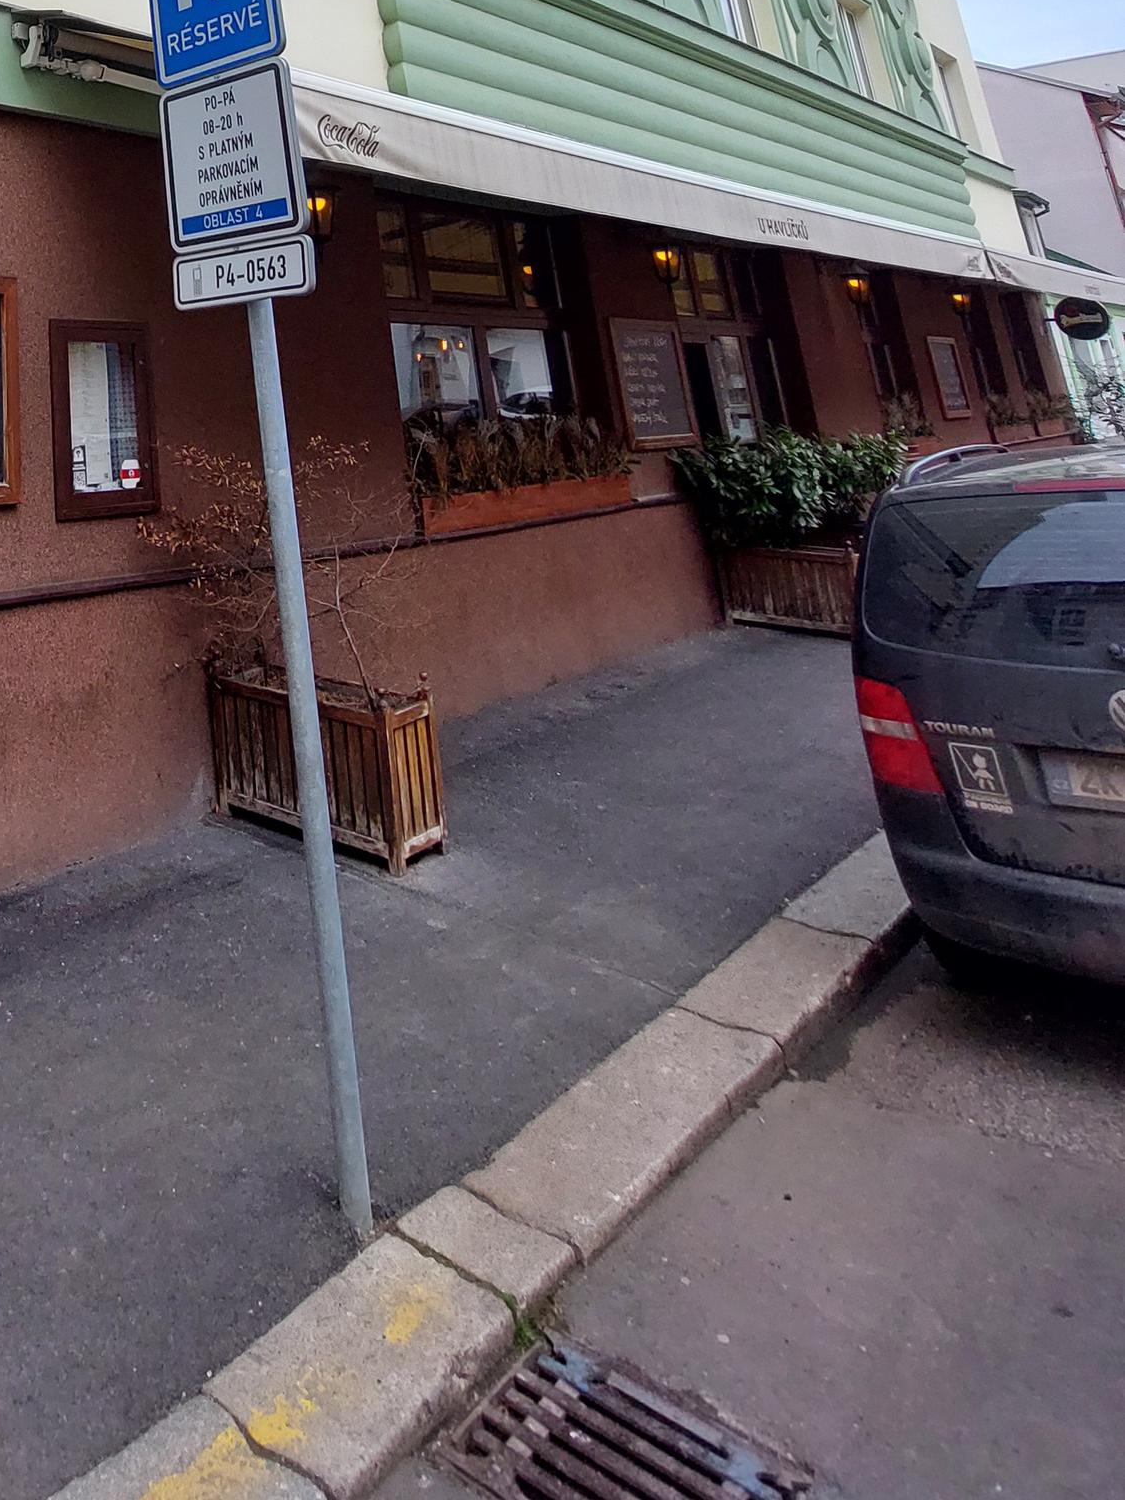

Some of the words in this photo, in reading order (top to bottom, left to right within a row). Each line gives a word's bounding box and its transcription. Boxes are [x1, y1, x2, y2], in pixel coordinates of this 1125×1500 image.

[204, 86, 236, 113] PO-PÁ
[202, 115, 233, 136] 08-20
[236, 112, 244, 127] h
[198, 146, 206, 160] S
[208, 132, 254, 160] PLATNÝM
[197, 156, 259, 184] PARKOVACÍM
[198, 180, 264, 208] OPRÁVNĚNÍM
[203, 207, 250, 230] OBLAST
[254, 204, 264, 220] 4
[757, 217, 766, 234] U
[767, 217, 809, 241] HAVLÍČKŮ
[215, 254, 287, 290] P4-0563
[923, 720, 996, 740] TOURAN
